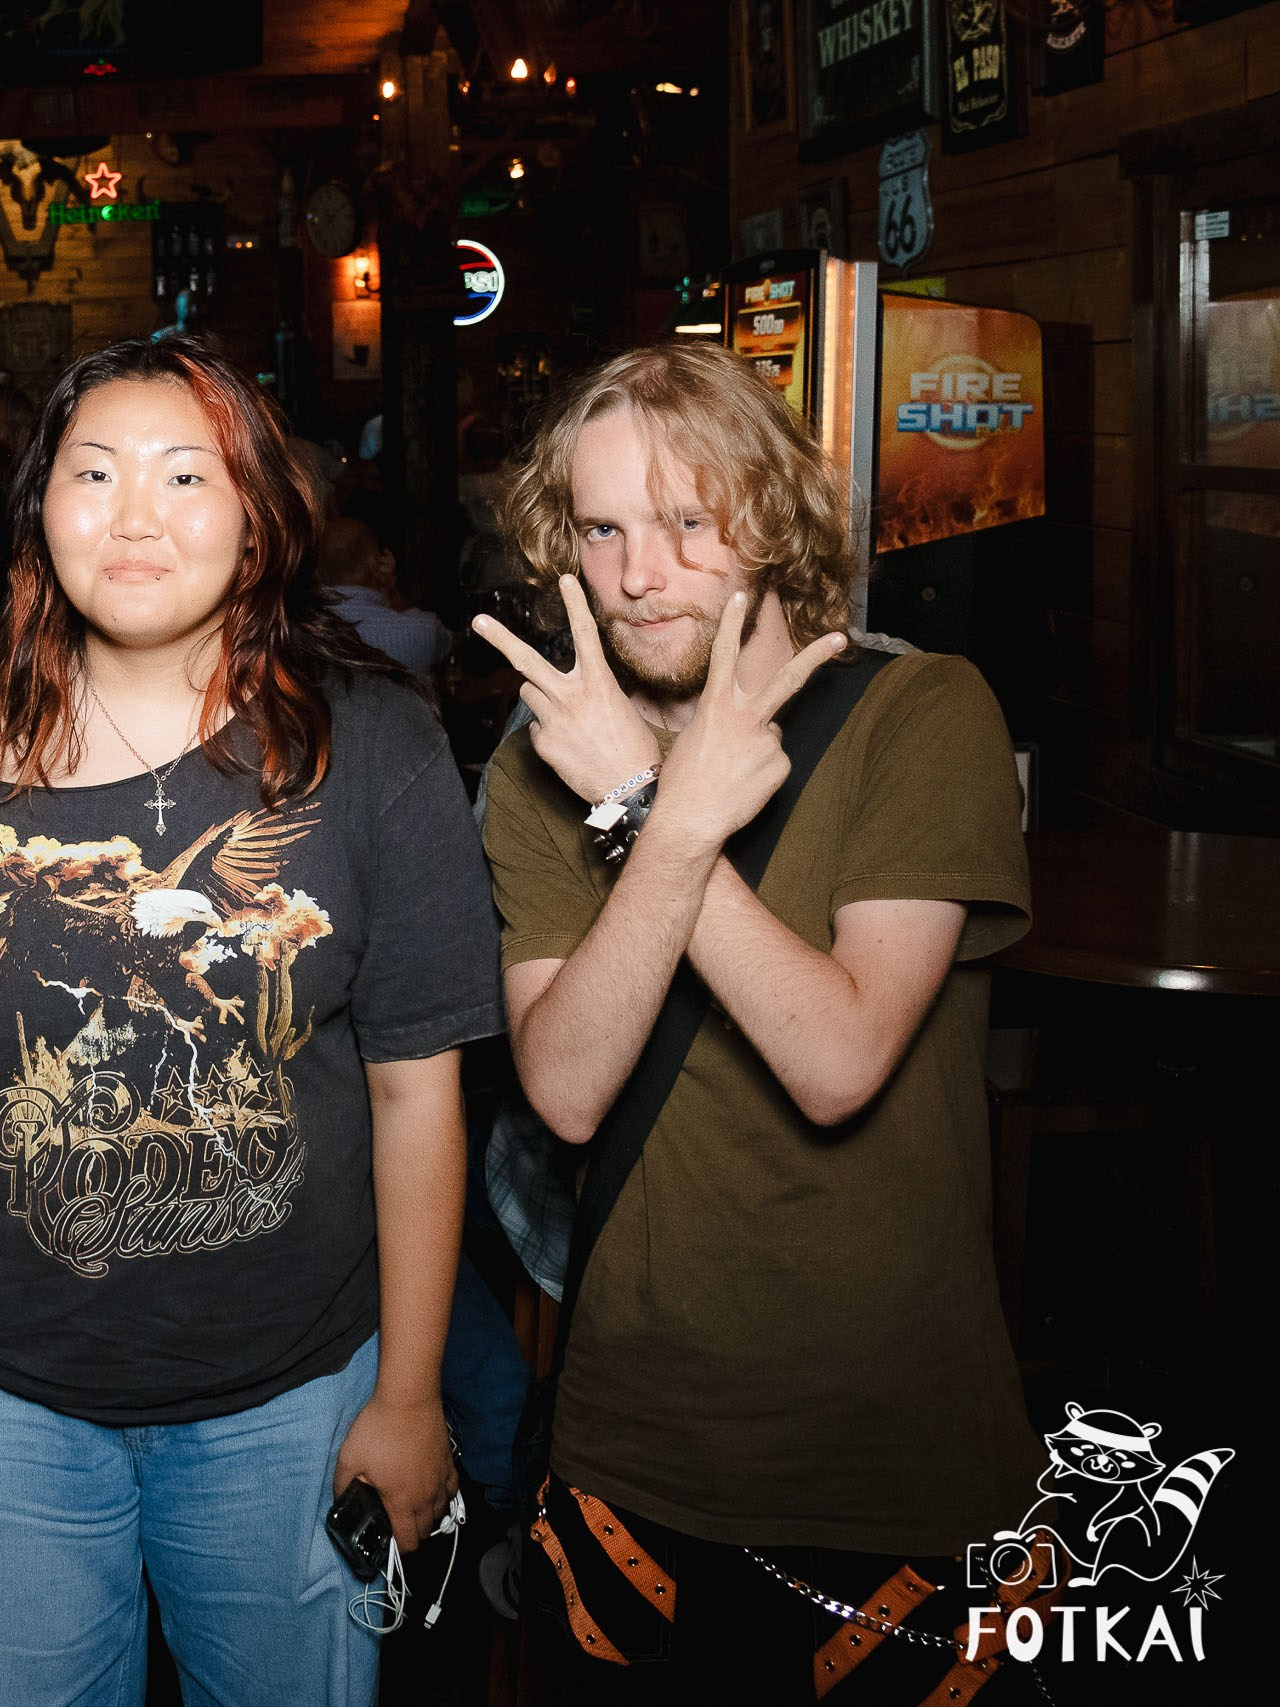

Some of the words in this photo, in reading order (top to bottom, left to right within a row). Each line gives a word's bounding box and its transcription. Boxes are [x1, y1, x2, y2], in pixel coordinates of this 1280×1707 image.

[817, 0, 914, 69] WHISKEY
[972, 44, 1001, 82] PASO
[885, 193, 917, 257] 66
[769, 280, 795, 300] SHOT
[910, 373, 1022, 401] FIRE
[897, 402, 1034, 433] SHOT
[52, 1142, 306, 1279] Sunset
